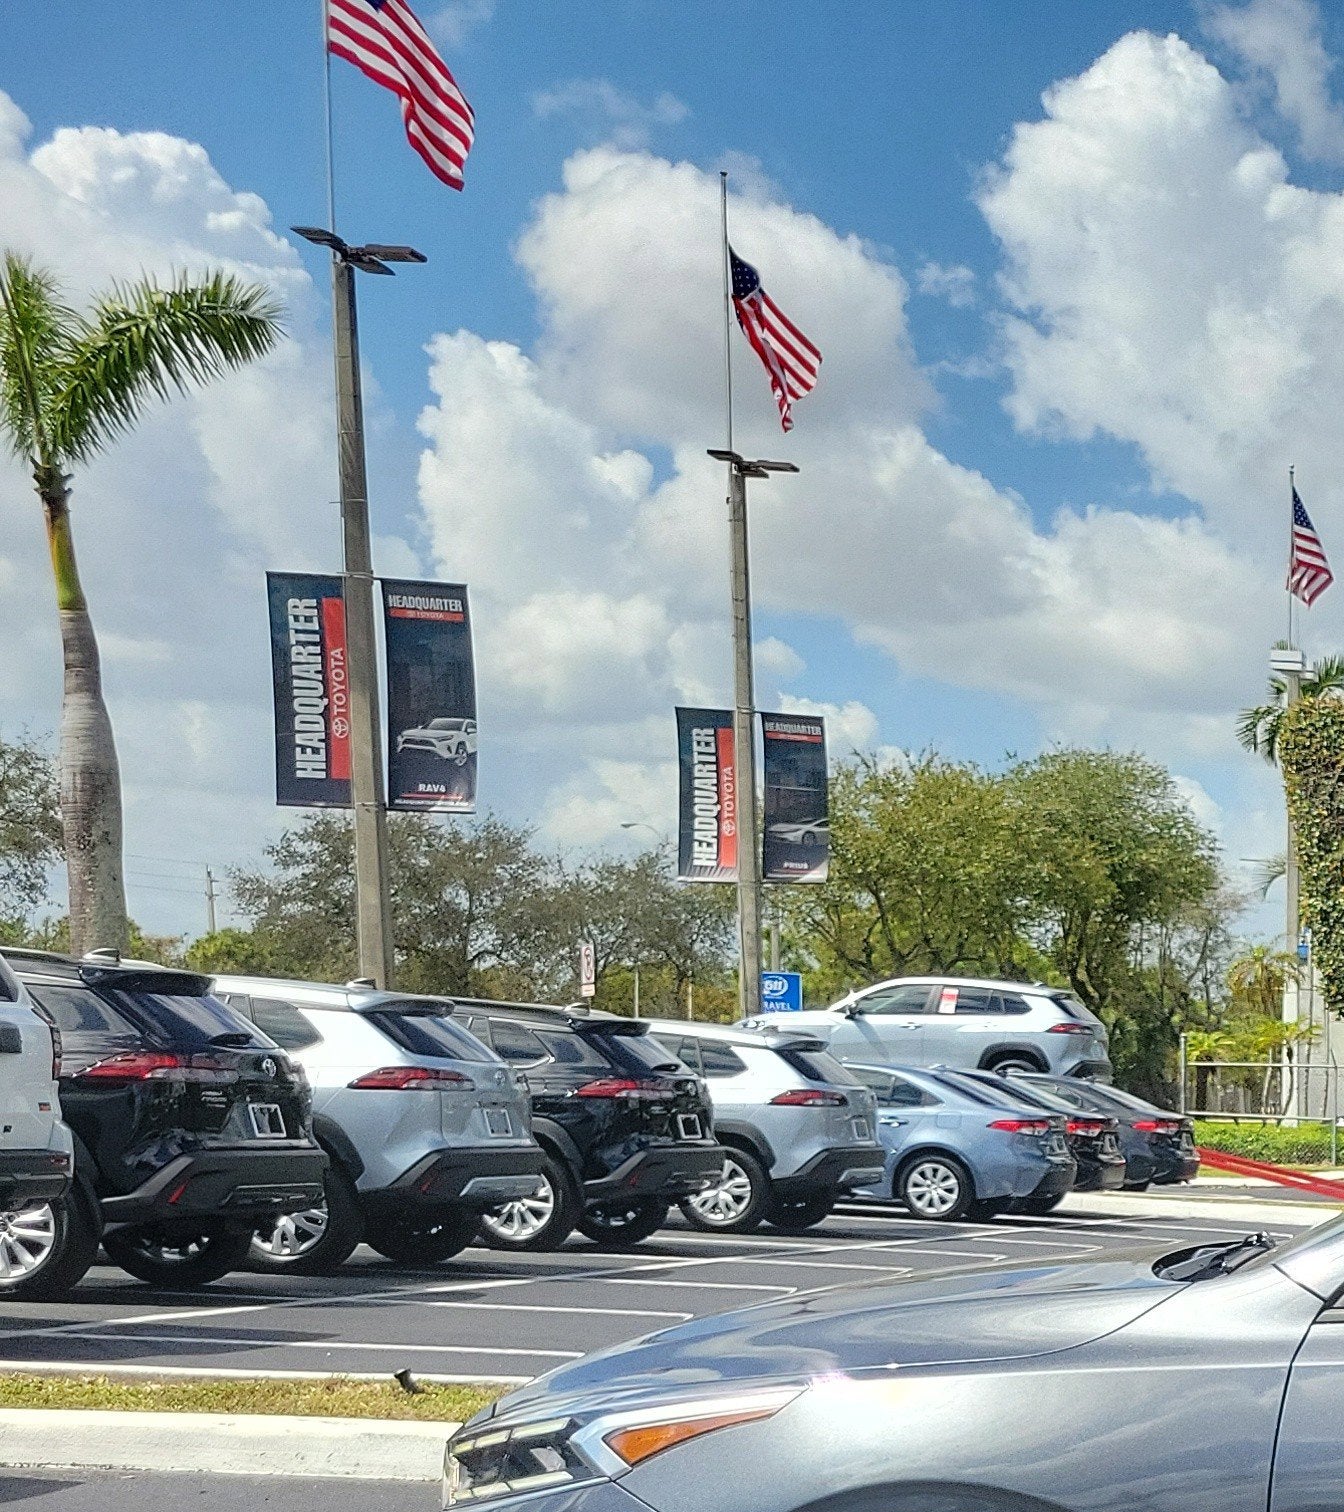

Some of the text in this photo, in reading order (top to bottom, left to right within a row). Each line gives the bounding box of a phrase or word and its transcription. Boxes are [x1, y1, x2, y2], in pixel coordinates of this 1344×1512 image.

[388, 594, 463, 612] HEADQUARTER
[287, 598, 329, 779] HEADQUARTER
[330, 647, 347, 716] TOYOTA
[417, 783, 447, 793] RAV4
[692, 727, 722, 867] HEADQUARTER
[722, 766, 736, 822] TOYOTA
